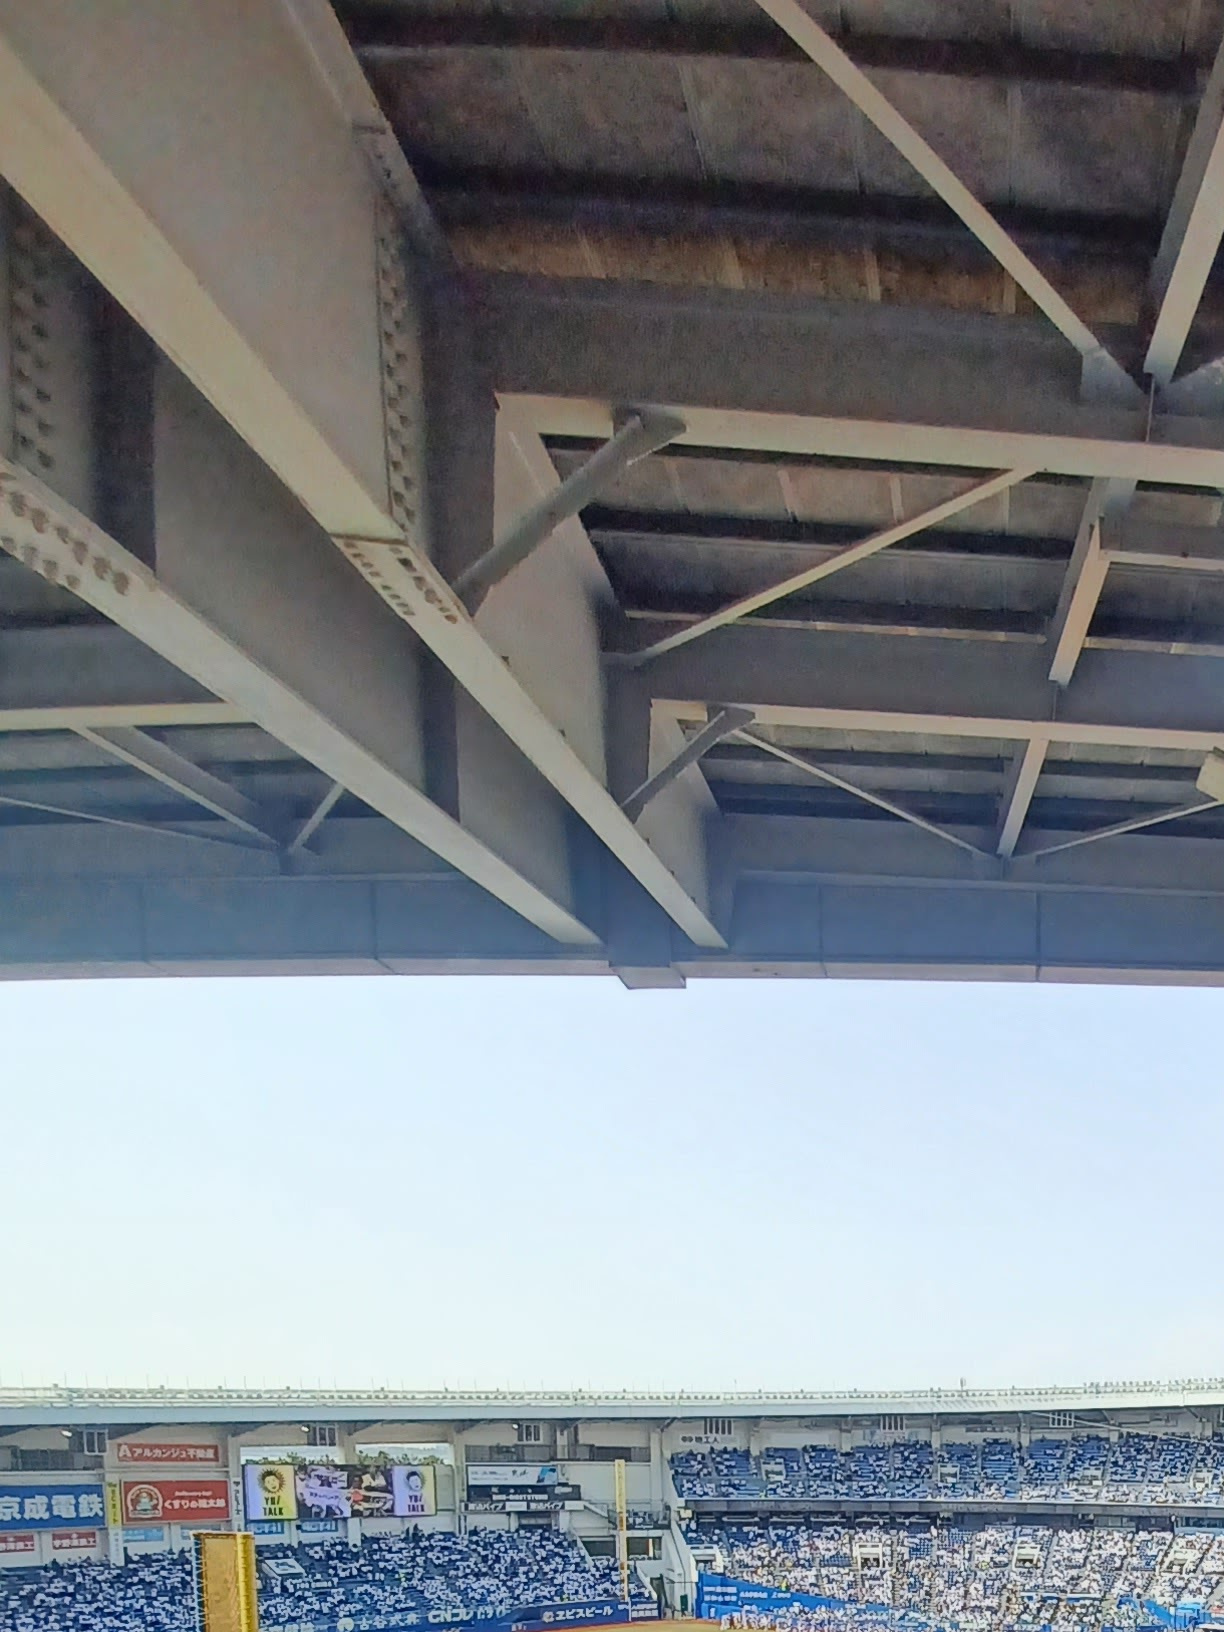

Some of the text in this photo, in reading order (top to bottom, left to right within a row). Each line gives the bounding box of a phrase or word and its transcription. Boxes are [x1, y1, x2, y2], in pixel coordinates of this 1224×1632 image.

[0, 1494, 104, 1520] 京成電鉄
[262, 1507, 284, 1516] TALK
